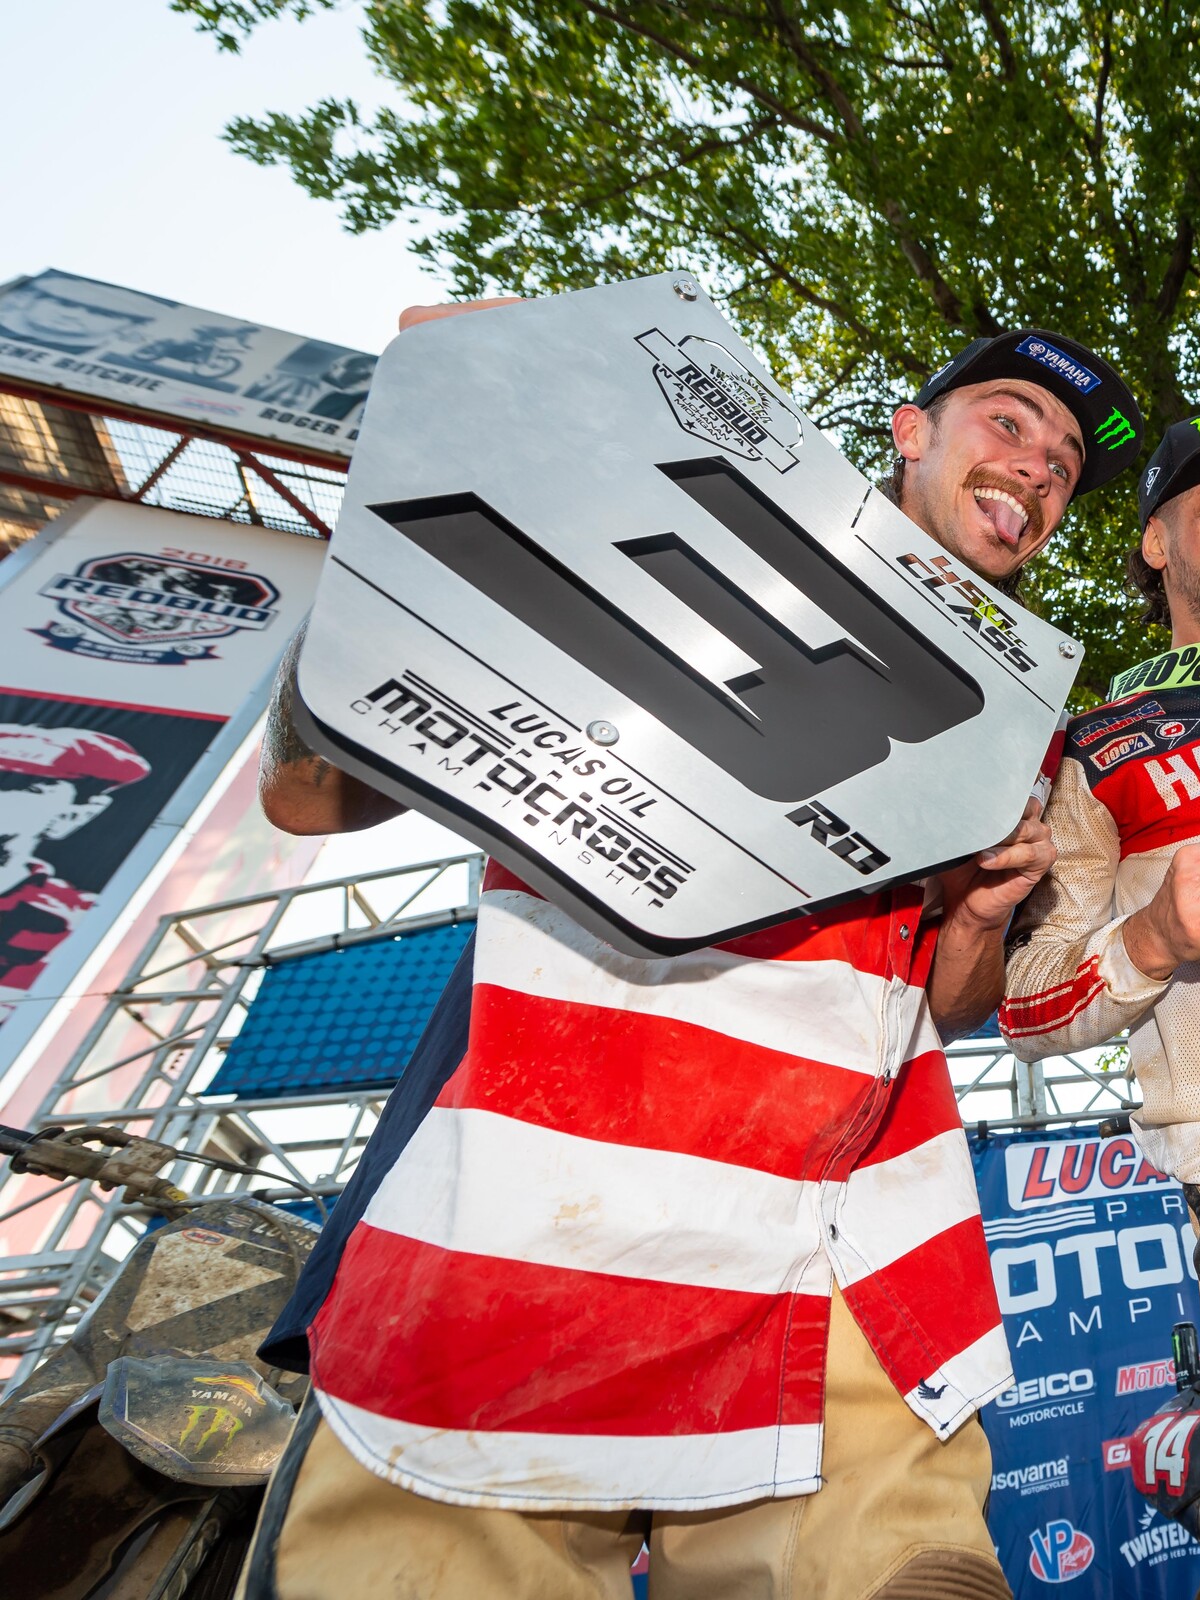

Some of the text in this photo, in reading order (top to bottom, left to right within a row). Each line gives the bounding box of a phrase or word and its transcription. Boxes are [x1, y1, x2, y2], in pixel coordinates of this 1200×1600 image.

[1028, 351, 1083, 387] RACING
[1043, 348, 1091, 387] YAMAHA
[658, 367, 758, 458] NATIONAL
[676, 363, 768, 445] REDBUD
[709, 363, 774, 424] TWISTED TEA
[259, 406, 341, 436] ROGER
[673, 398, 723, 441] MICHIGAN
[675, 392, 731, 442] BUCHANAN
[53, 577, 272, 623] REDBUD
[84, 594, 228, 622] NATIONAL
[895, 553, 1039, 673] CLASS
[365, 455, 986, 803] 3
[1072, 701, 1164, 744] PARTS
[1078, 709, 1167, 747] UNLIMITED
[488, 701, 659, 819] LUCAS OIL
[1100, 736, 1145, 767] 100%
[350, 699, 665, 909] CHAMPIONSHIP
[364, 678, 687, 900] MOTOCROSS
[784, 799, 892, 876] RD
[1021, 1138, 1170, 1202] LUCA
[1106, 1194, 1184, 1222] PR
[989, 1222, 1198, 1315] OTO
[190, 1389, 253, 1418] YAMAHA
[995, 1368, 1094, 1408] GEICO
[1009, 1402, 1084, 1429] MOTORCYCLE
[1143, 1415, 1200, 1487] 14
[990, 1459, 1068, 1492] usqvarna
[1020, 1479, 1070, 1496] MOTORCYCLES
[1028, 1519, 1075, 1583] VP
[1119, 1522, 1193, 1568] TWISTED
[1148, 1554, 1169, 1566] HARD
[1169, 1550, 1187, 1561] ICED
